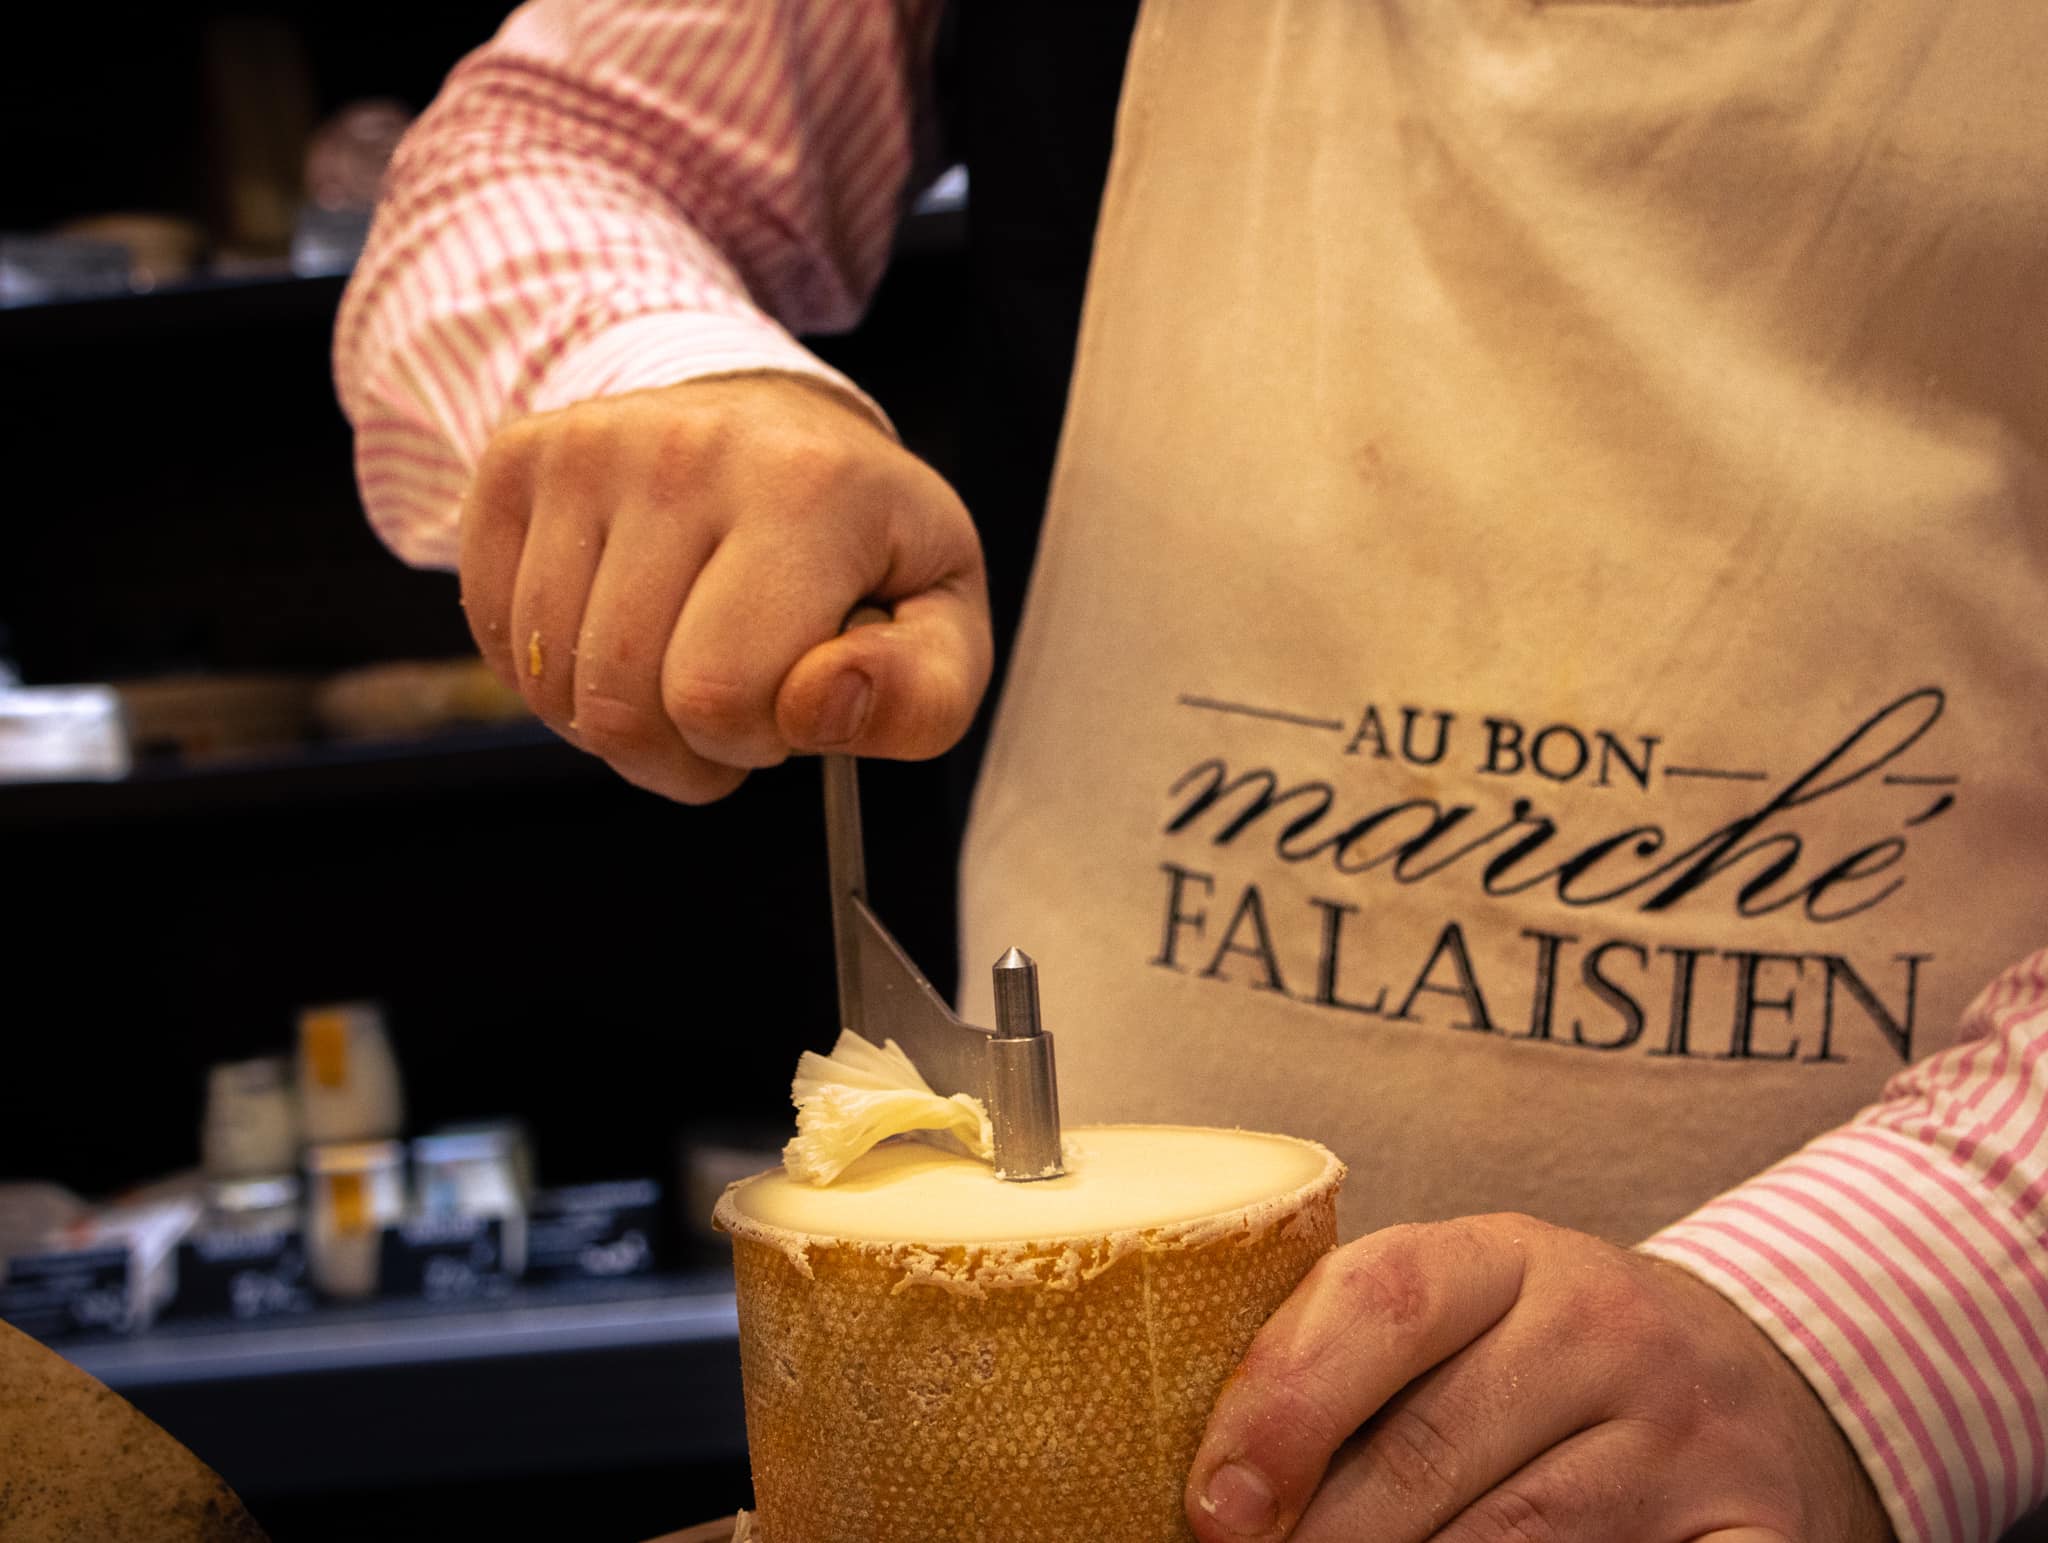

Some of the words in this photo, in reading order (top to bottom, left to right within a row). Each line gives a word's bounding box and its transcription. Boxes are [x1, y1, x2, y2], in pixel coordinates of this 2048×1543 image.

[1163, 687, 1957, 923] marché
[1343, 703, 1456, 766] AU
[1477, 717, 1661, 790] BON
[1148, 861, 1935, 1065] FALAISIEN
